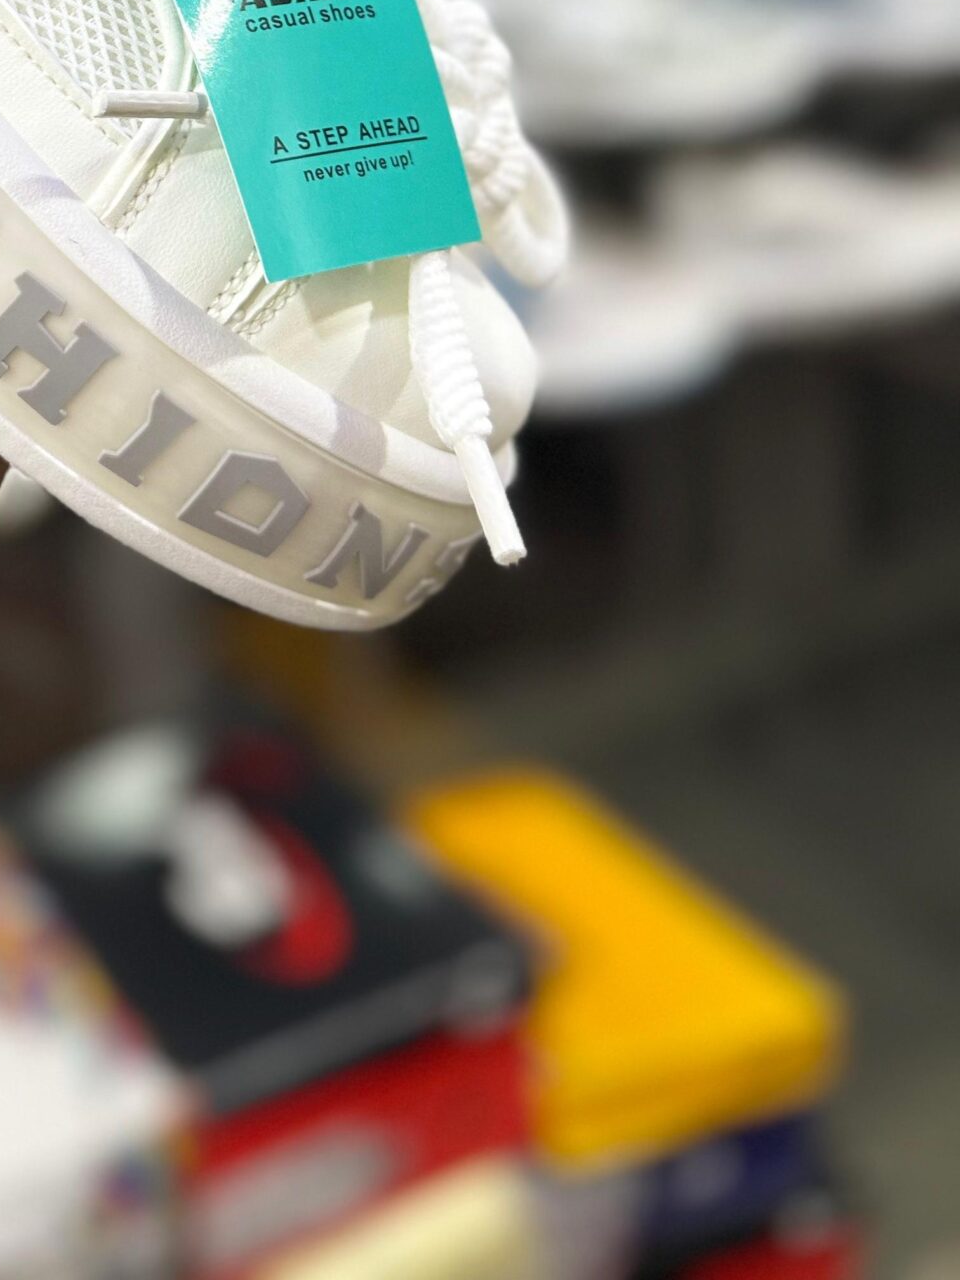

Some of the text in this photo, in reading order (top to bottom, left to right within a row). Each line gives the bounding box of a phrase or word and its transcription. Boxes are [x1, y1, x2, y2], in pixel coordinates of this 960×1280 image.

[245, 3, 376, 32] casual shoes
[273, 115, 420, 155] A STEP AHEAD
[304, 150, 414, 182] never give up!
